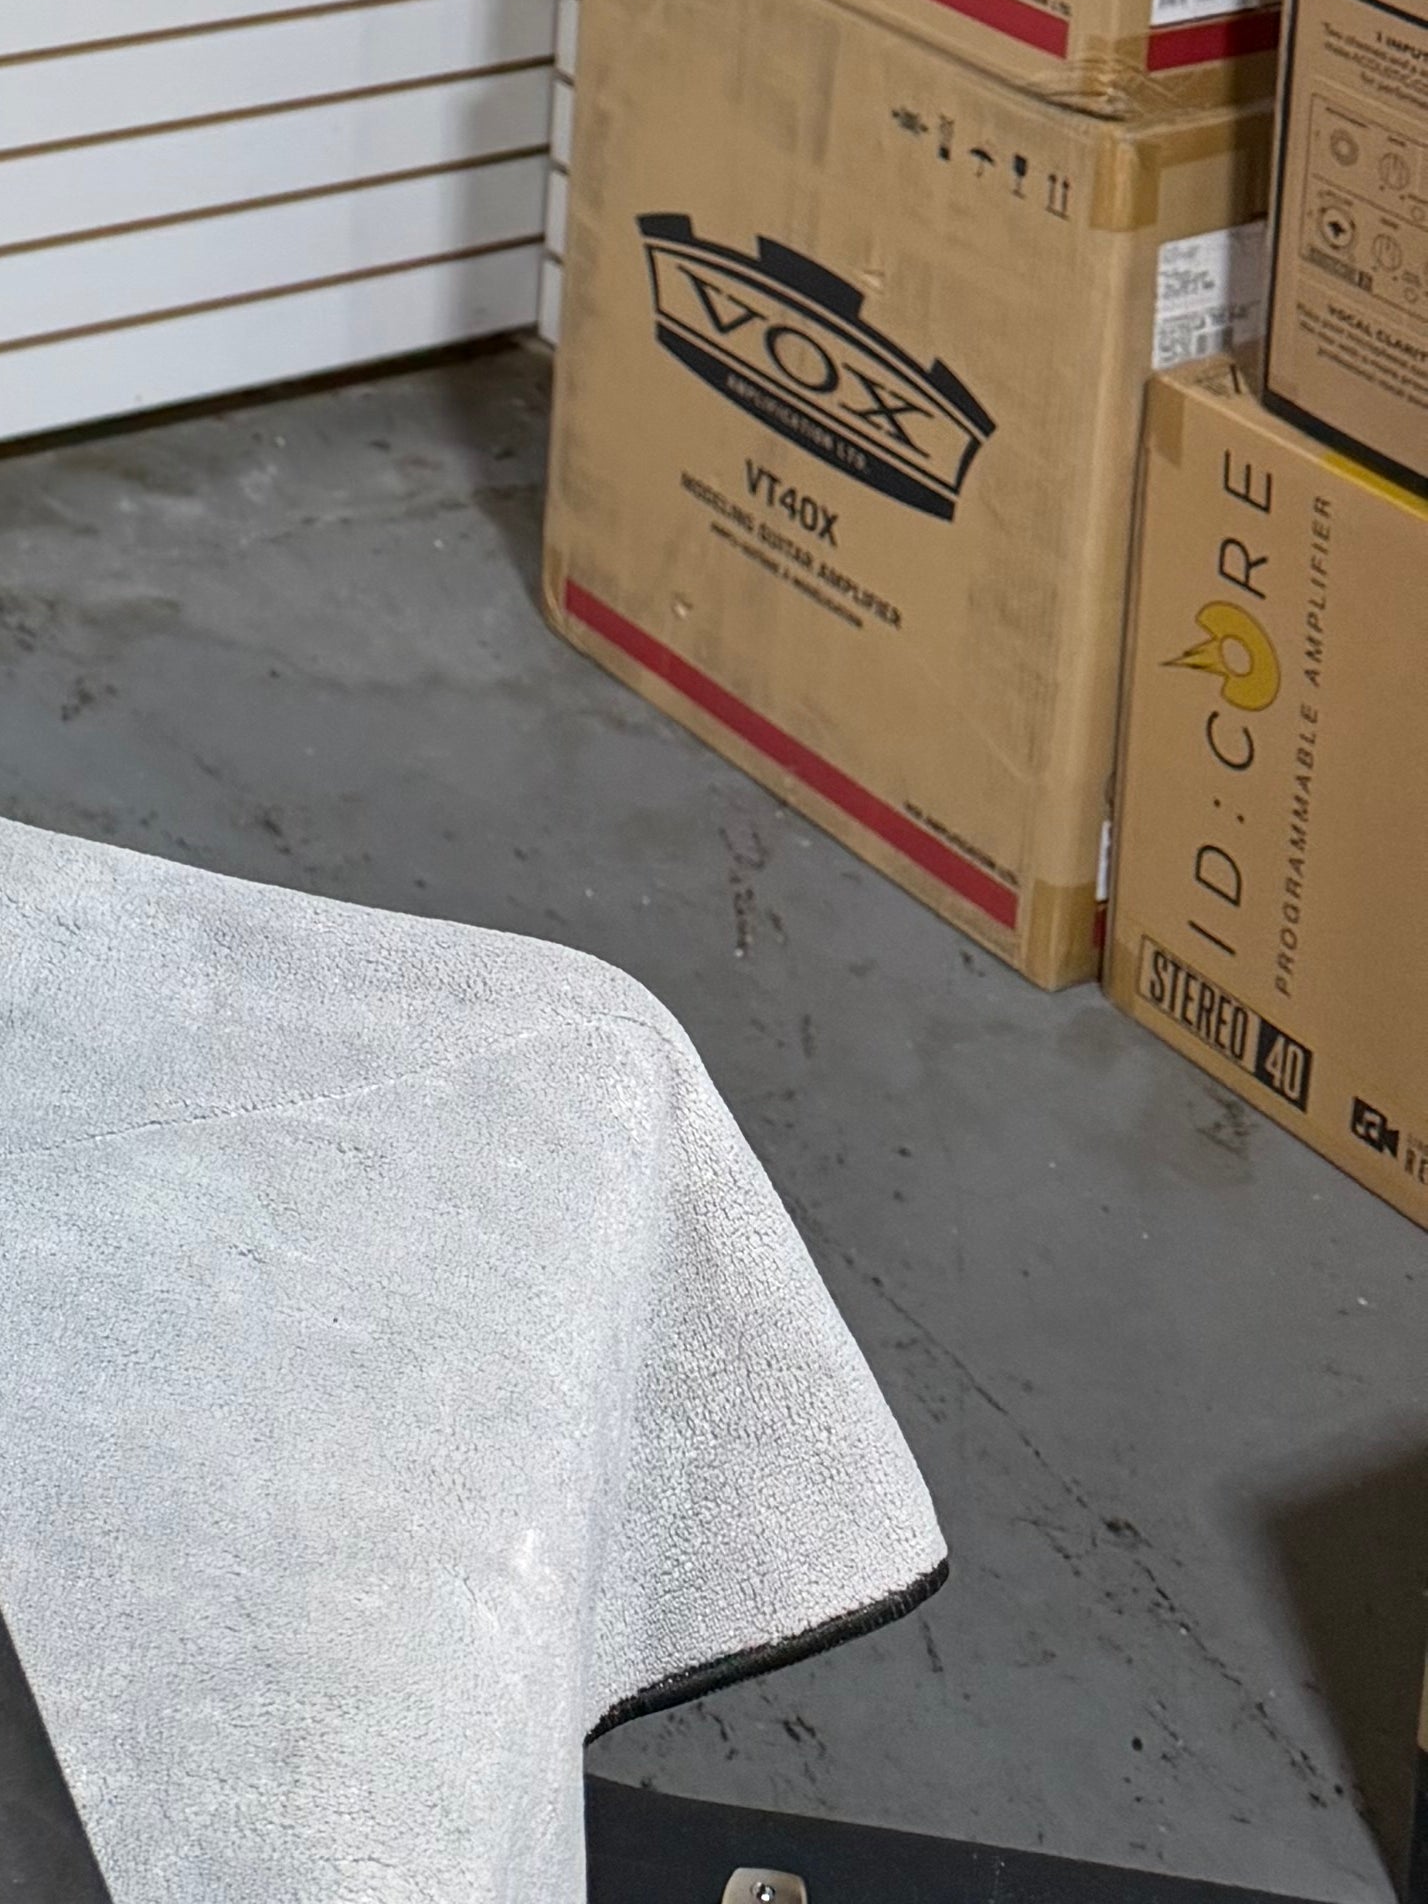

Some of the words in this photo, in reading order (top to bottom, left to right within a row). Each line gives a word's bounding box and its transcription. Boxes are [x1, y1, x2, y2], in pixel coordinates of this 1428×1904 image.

[675, 263, 935, 461] VOX
[744, 457, 840, 548] VT40X
[1275, 703, 1320, 999] PROGRAMMABLE
[1302, 495, 1333, 688] AMPLIFIER
[1149, 949, 1249, 1062] STEREO
[1264, 1036, 1305, 1101] 40
